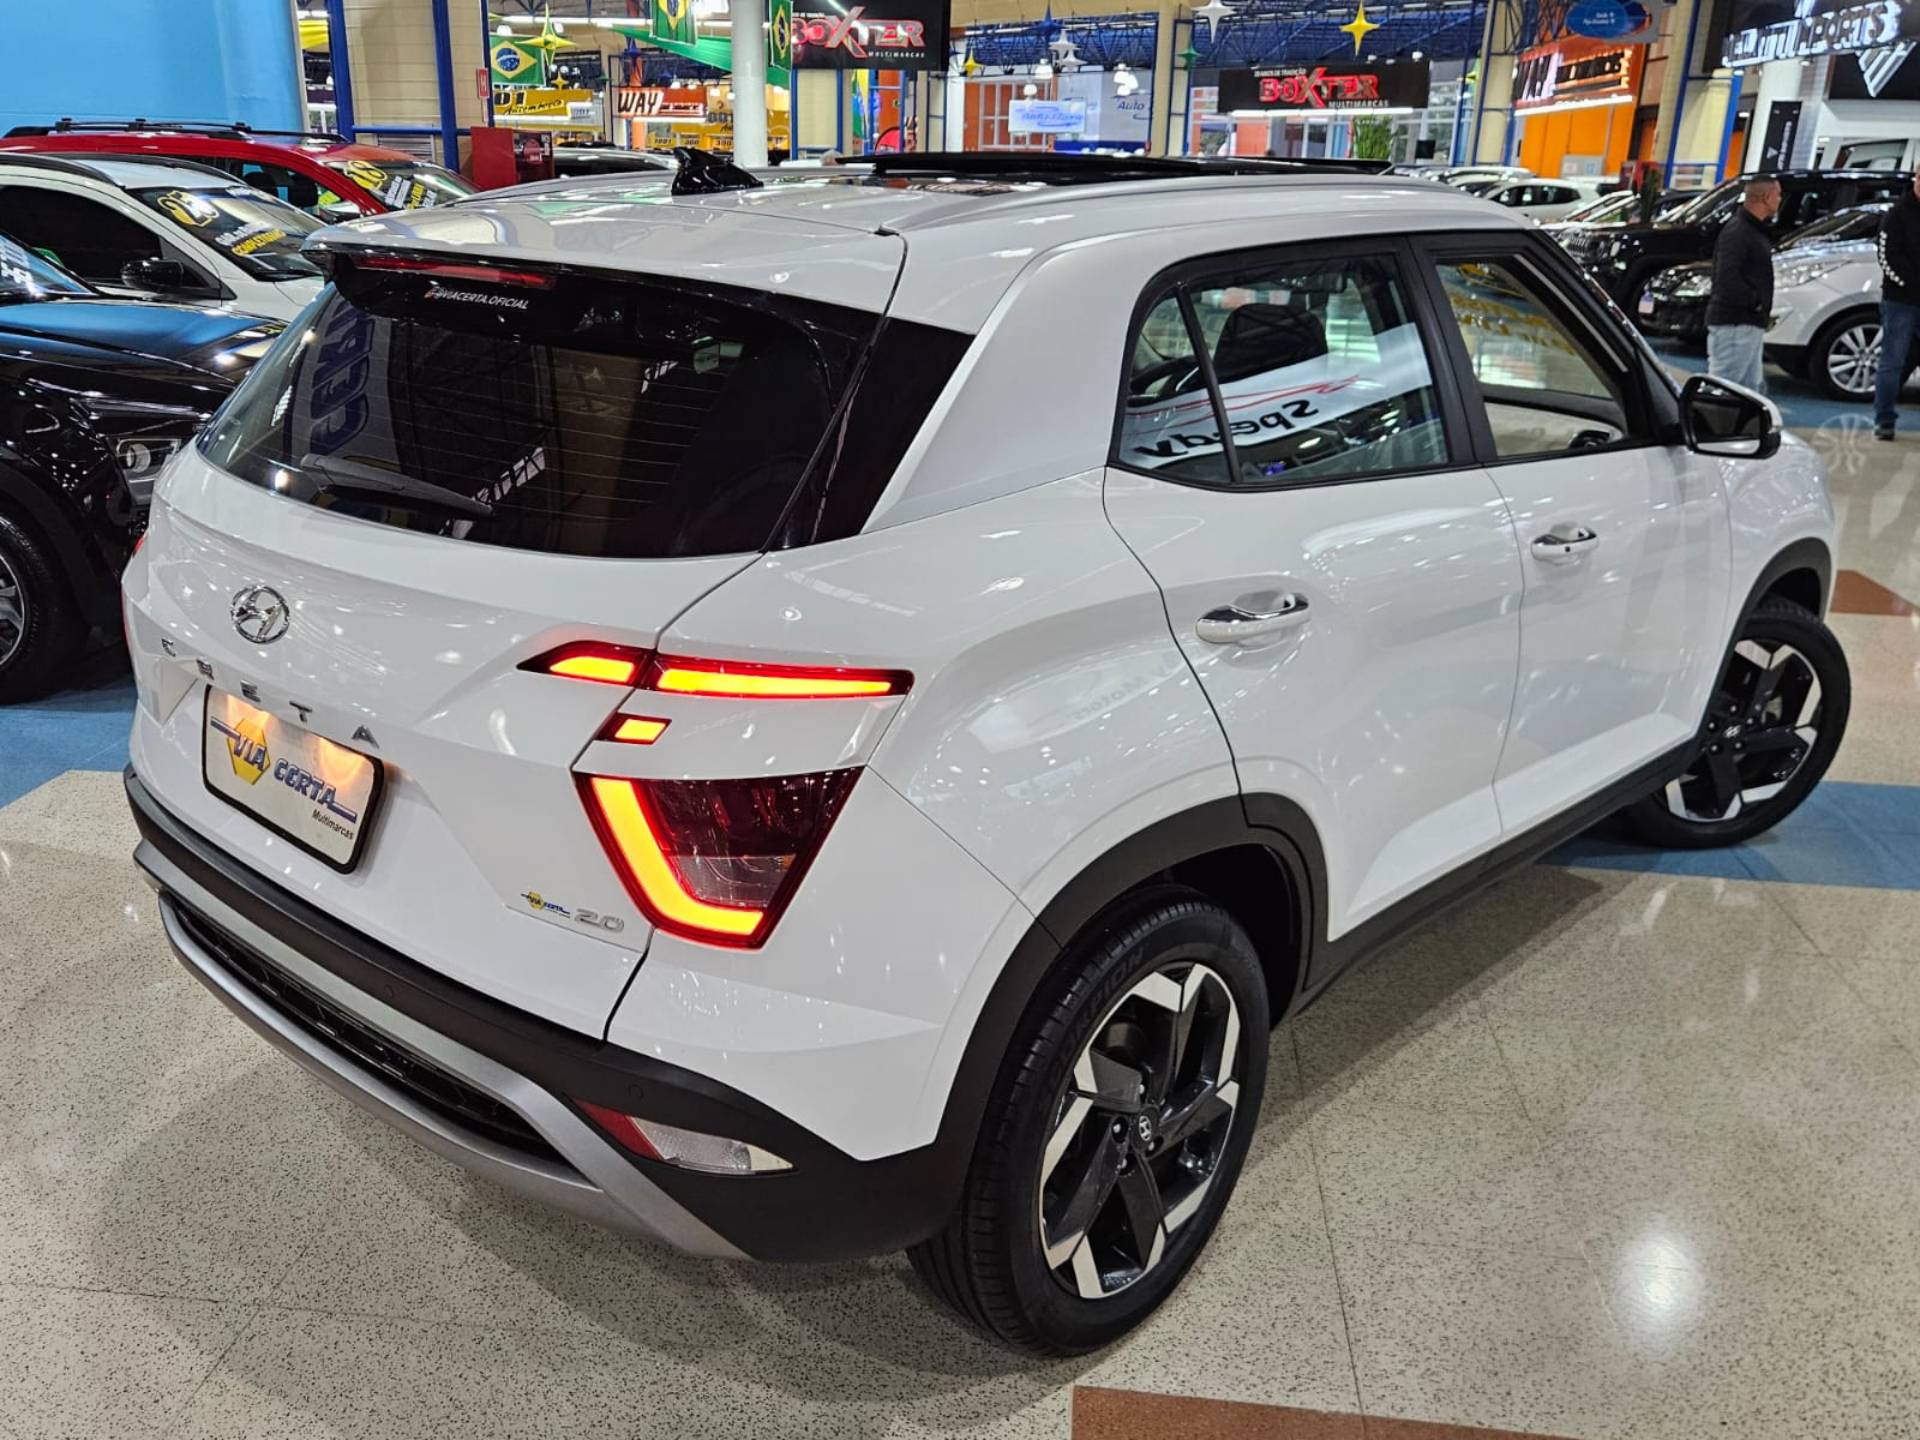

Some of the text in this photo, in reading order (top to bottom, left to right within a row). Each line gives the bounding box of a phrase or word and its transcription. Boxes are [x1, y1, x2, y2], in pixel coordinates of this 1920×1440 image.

[617, 91, 660, 114] WAY
[1260, 67, 1379, 109] BOXTER
[231, 734, 337, 805] VIA CERTA
[311, 808, 355, 841] Multimarcas
